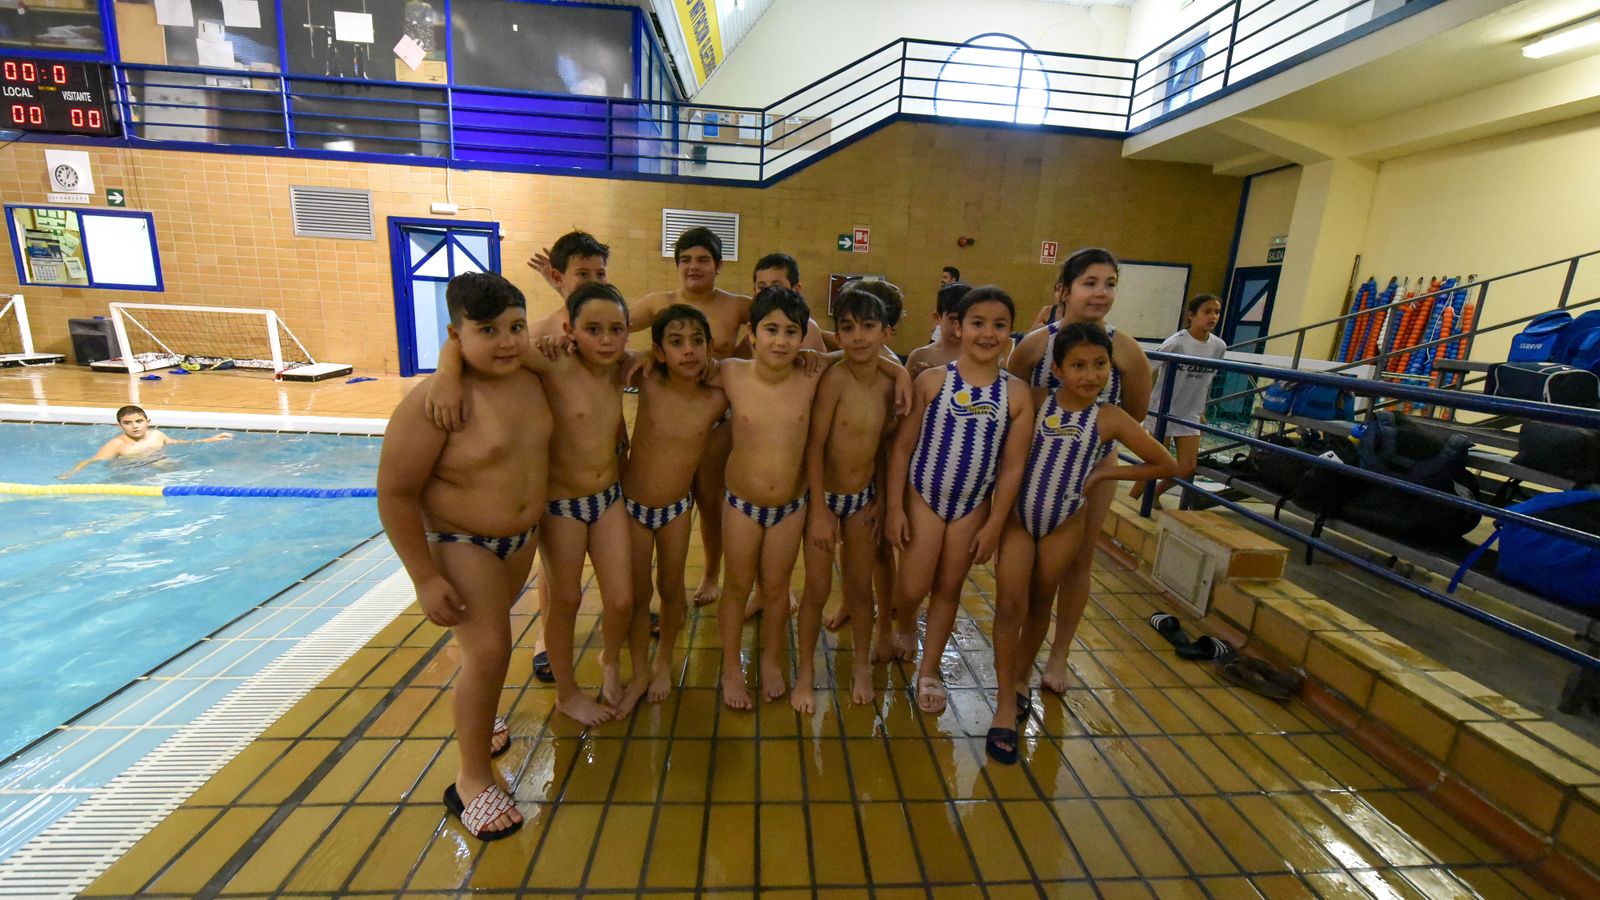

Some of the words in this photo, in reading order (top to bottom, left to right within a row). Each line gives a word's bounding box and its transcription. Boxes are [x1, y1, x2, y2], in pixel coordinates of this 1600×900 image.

[3, 86, 34, 98] LOCAL
[62, 90, 92, 102] VISITANTE
[12, 105, 42, 124] 00
[71, 109, 101, 128] 00
